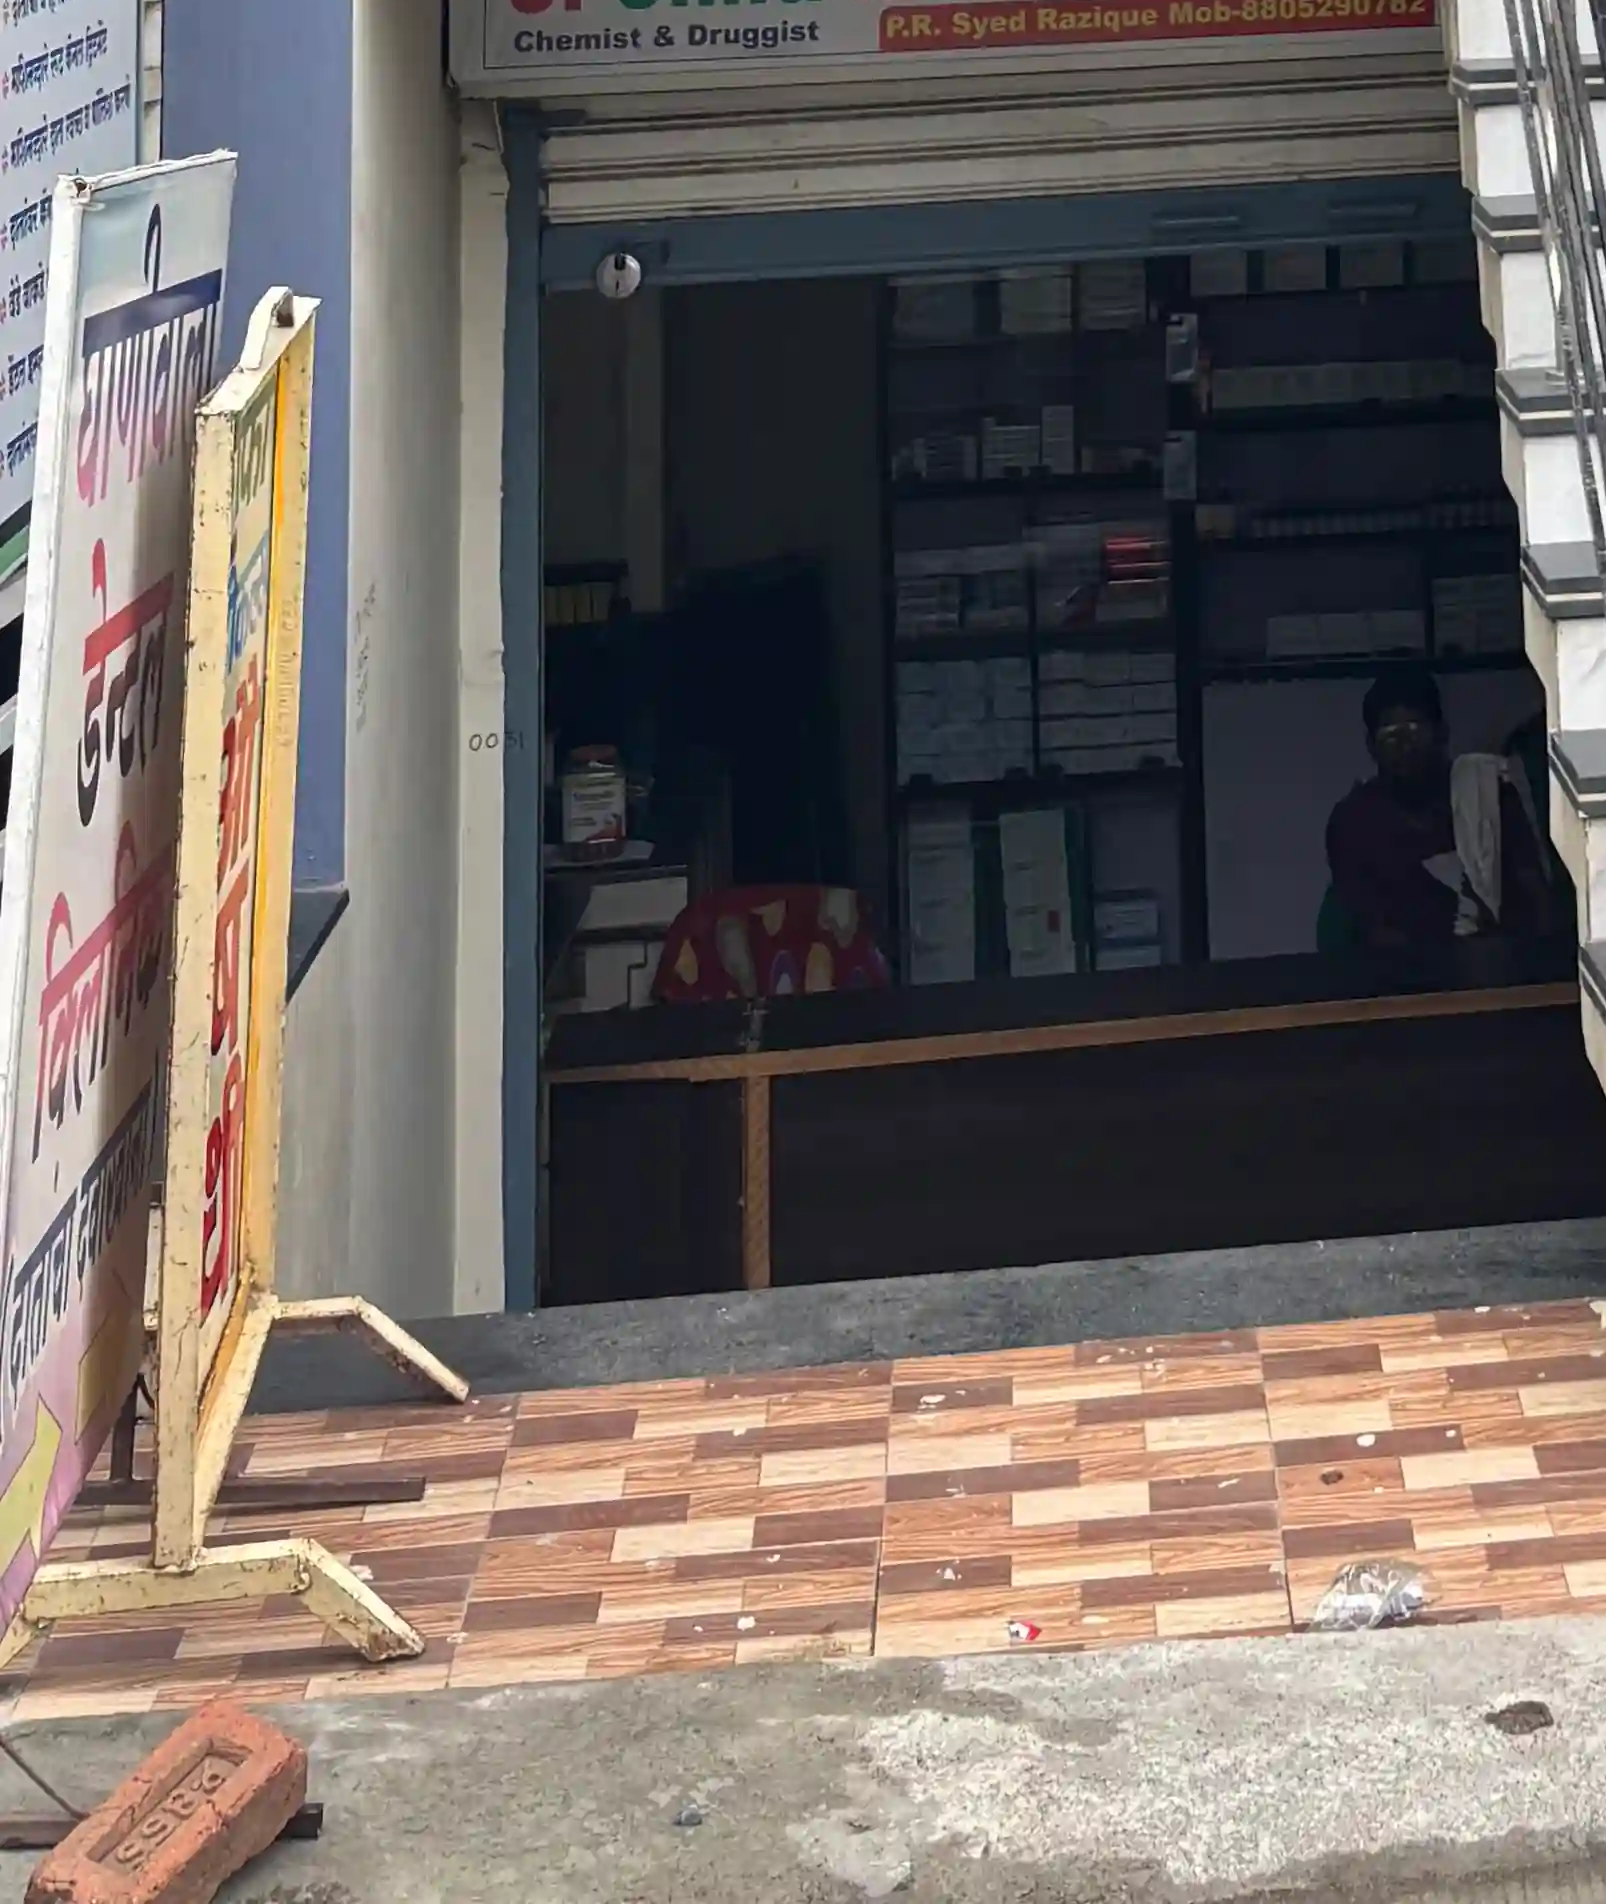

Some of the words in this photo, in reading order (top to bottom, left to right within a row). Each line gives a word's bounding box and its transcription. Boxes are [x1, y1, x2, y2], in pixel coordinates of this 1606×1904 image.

[514, 26, 642, 54] Chemist
[653, 24, 675, 48] &
[688, 19, 820, 49] Druggist
[886, 12, 941, 39] P.R.
[952, 8, 1026, 40] Syed
[1036, 4, 1159, 33] Razique
